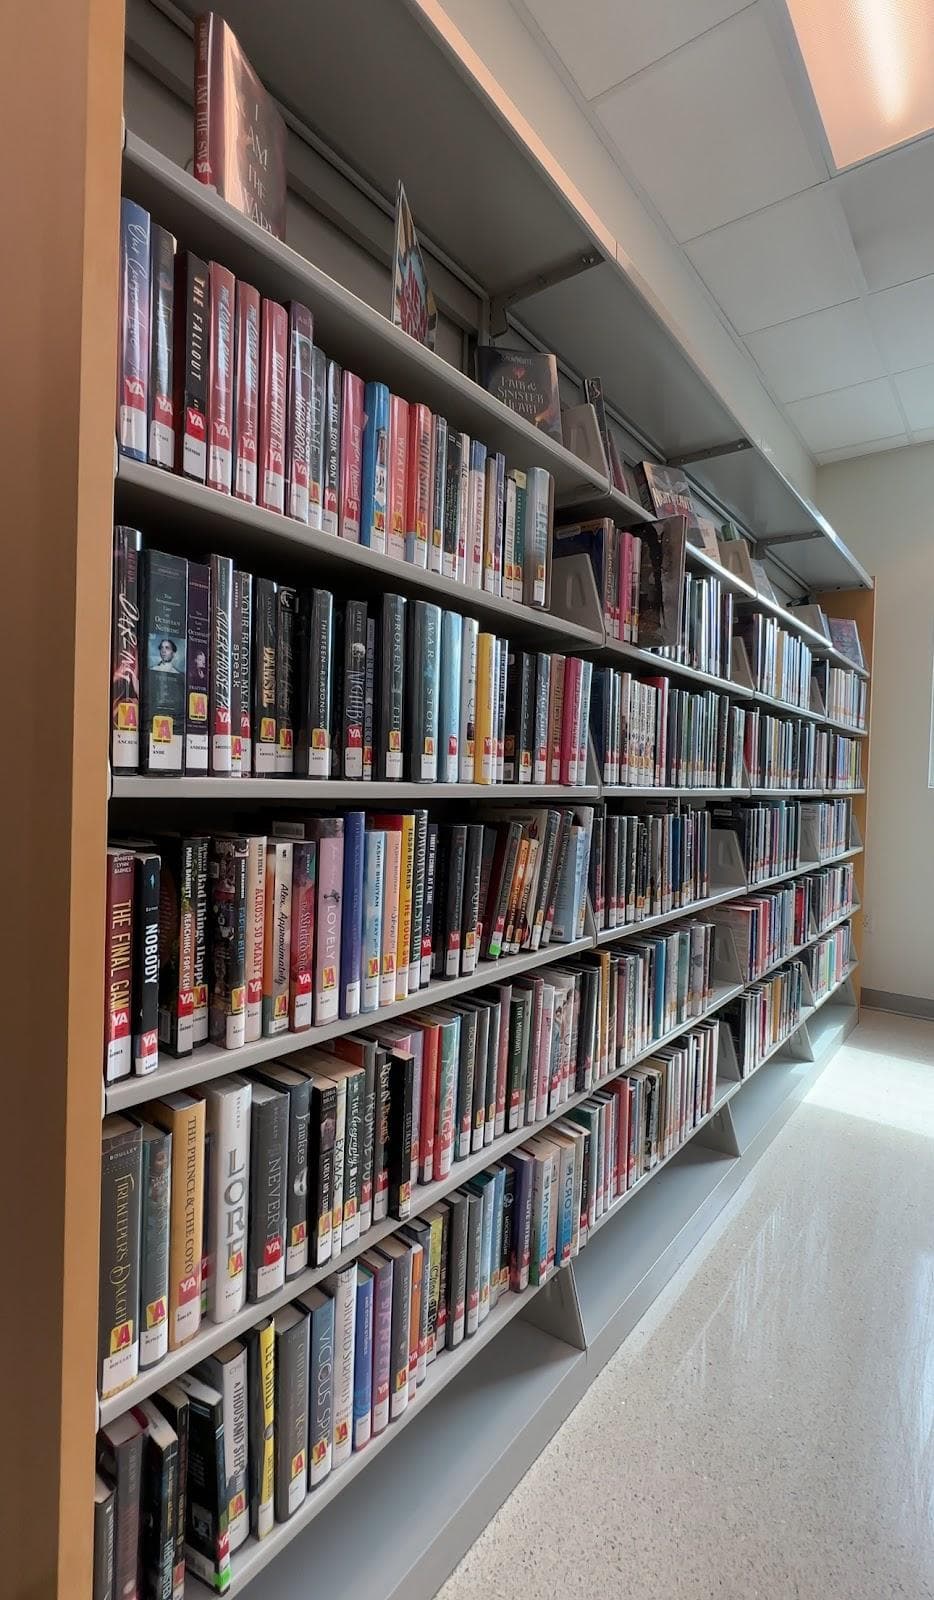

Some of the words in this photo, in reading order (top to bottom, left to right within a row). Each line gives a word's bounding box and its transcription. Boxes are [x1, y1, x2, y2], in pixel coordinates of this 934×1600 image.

[192, 277, 206, 307] THE
[190, 312, 204, 382] FALLOUT
[189, 410, 204, 430] YA
[330, 428, 339, 453] BOOK
[118, 593, 140, 681] DARLING
[427, 621, 435, 660] WAR
[216, 654, 231, 690] HOUSE
[231, 643, 241, 688] speak
[262, 646, 277, 708] DAMSEL
[346, 669, 365, 725] NIGHTBA
[426, 687, 434, 733] STOR
[185, 847, 193, 868] MAIJA
[417, 815, 428, 881] MADWOMAN
[427, 852, 435, 876] SECONDS
[198, 873, 208, 898] Bad
[405, 855, 413, 890] BICKERS
[112, 899, 132, 930] THE
[196, 902, 207, 944] Things
[254, 888, 264, 924] ACROSS
[404, 899, 412, 917] THE
[414, 882, 424, 932] CHELSEA
[183, 913, 193, 953] REACHING
[254, 926, 263, 939] SO
[275, 911, 289, 987] Approximately
[326, 904, 337, 961] LOVELY
[110, 932, 131, 978] FINAL
[144, 922, 159, 984] NOBODY
[182, 955, 191, 971] FOR
[253, 940, 263, 975] MANY
[249, 981, 262, 993] YA
[298, 973, 311, 984] YA
[180, 992, 194, 1005] YA
[112, 1012, 128, 1027] YA
[142, 1033, 158, 1048] YA
[351, 1096, 360, 1115] THE
[187, 1115, 198, 1144] THE
[295, 1112, 310, 1165] Fawkes
[348, 1115, 361, 1167] Geography
[186, 1146, 198, 1196] PRINCE
[334, 1137, 344, 1191] EX-MAS
[186, 1196, 197, 1208] &
[267, 1157, 282, 1230] NEVER
[349, 1176, 357, 1199] LOST
[114, 1173, 134, 1262] FIREKEEPER'S
[185, 1209, 197, 1238] THE
[184, 1238, 195, 1275] COYO
[265, 1240, 281, 1254] YA
[109, 1263, 131, 1323] DAUGHT
[180, 1276, 196, 1292] YA
[342, 1301, 353, 1351] SILVERED
[265, 1344, 274, 1369] LEE
[316, 1327, 332, 1405] VICIOUS
[265, 1373, 274, 1410] CHILD
[341, 1353, 352, 1404] SERPENTS
[233, 1387, 245, 1444] THOUSAND
[232, 1446, 246, 1476] STEPS
